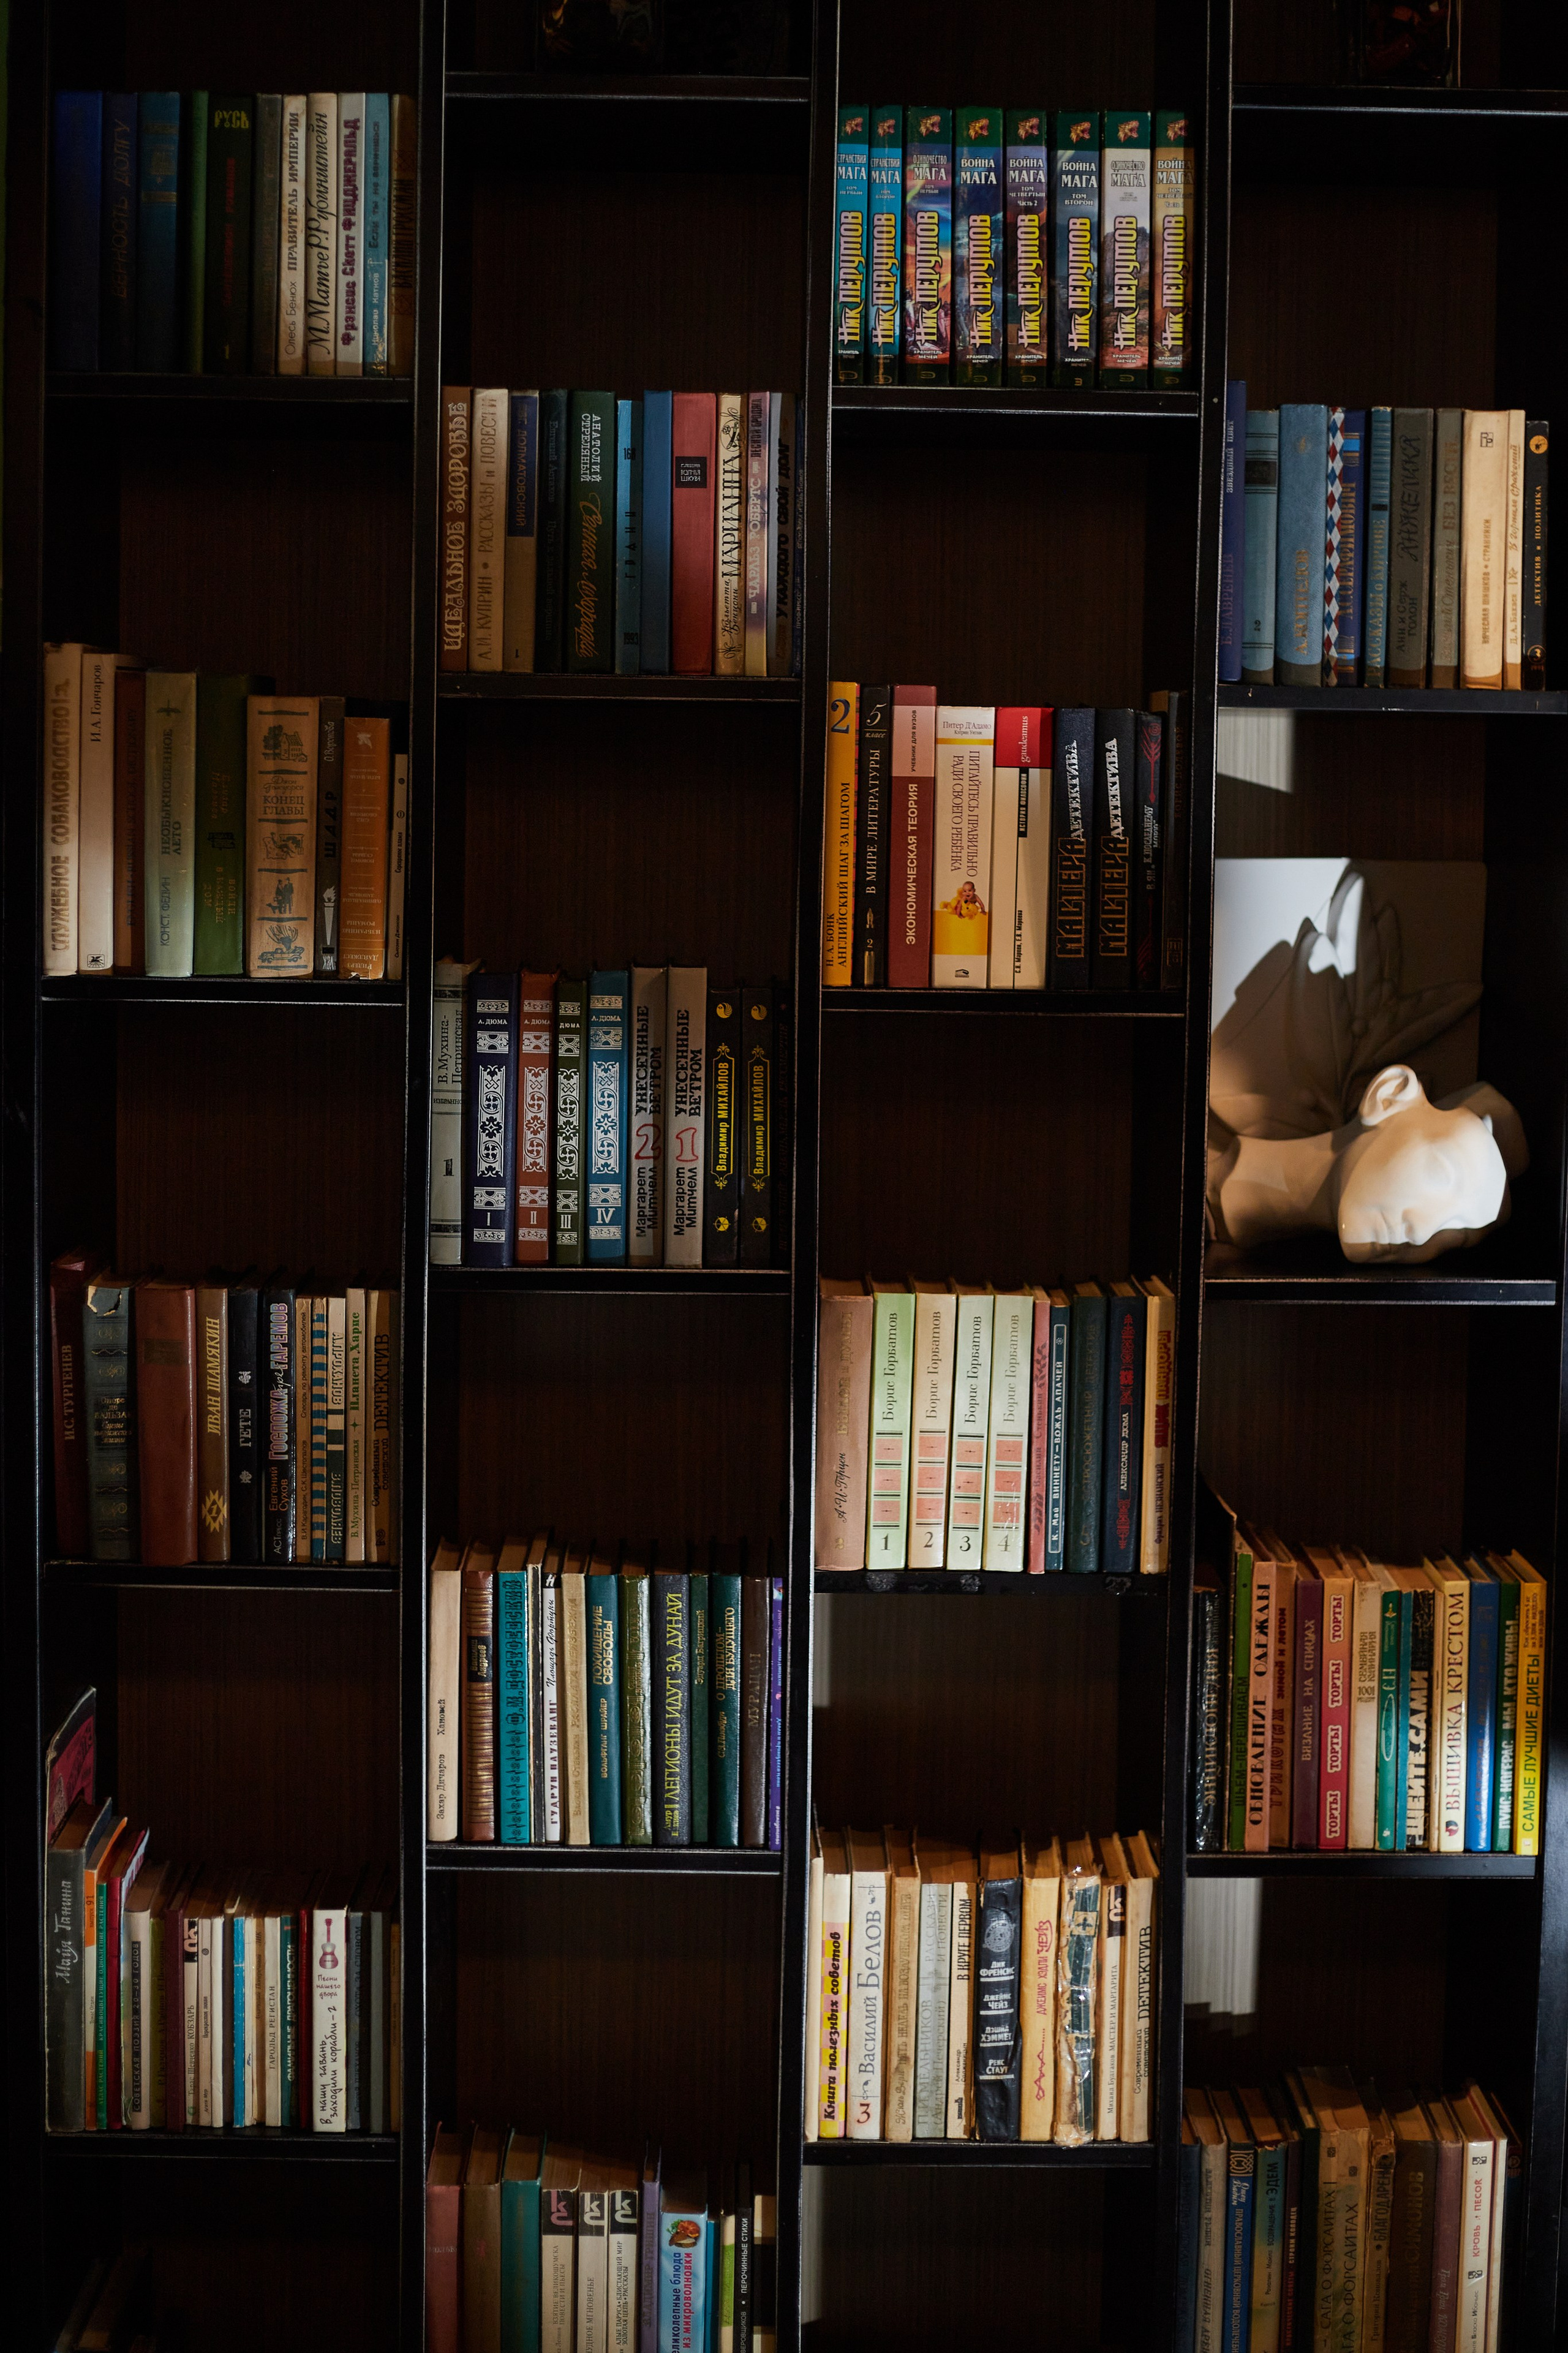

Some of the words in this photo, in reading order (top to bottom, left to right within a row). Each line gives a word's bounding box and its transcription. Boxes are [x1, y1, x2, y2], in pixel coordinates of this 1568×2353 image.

[214, 110, 249, 129] РУСЬ
[288, 113, 298, 183] ИМПЕРИИ
[342, 119, 360, 231] ФИЦДЖЕРАЛЬД
[961, 159, 995, 168] ВОЙНА
[1008, 159, 1044, 168] ВОЙНА
[1008, 170, 1046, 182] МАГА
[1061, 161, 1096, 171] ВОЙНА
[961, 172, 997, 184] МАГА
[1061, 175, 1098, 187] МАГА
[287, 189, 298, 271] ПРАВИТЕЛЬ
[285, 281, 297, 316] Бенюх
[341, 281, 357, 346] Фрэнсис
[285, 321, 297, 355] Олесь
[448, 402, 468, 513] ЗДОРОВЬЕ
[480, 398, 496, 464] ПОВЕСТИ
[580, 414, 590, 482] СТРЕЛЯНЫЙ
[591, 414, 601, 482] АНАТОЛИЙ
[478, 483, 495, 552] РАССКАЗЫ
[722, 453, 742, 577] МАРИАННА
[750, 478, 761, 538] РОБЕРТС
[1397, 434, 1420, 561] АНЖЕЛИКА
[444, 521, 466, 650] ИДЕАЛЬНОЕ
[748, 546, 760, 599] ЧАРЛЬЗ
[476, 576, 492, 629] КУПРИН
[1365, 594, 1382, 677] РАССКАЗЫ
[91, 665, 102, 715] Гончаров
[831, 698, 850, 734] 2
[1020, 716, 1030, 762] gaudeamus
[51, 706, 69, 845] СОБАКОВОДСТВО
[161, 729, 173, 855] НЕОБЫКНОВЕННОЕ
[867, 749, 880, 840] ЛИТЕРАТУРЫ
[1065, 740, 1084, 841] ДЕТЕКТИВА
[1104, 738, 1124, 839] ДЕТЕКТИВА
[840, 782, 850, 830] ШАГОМ
[908, 784, 918, 831] ТЕОРИЯ
[951, 785, 962, 823] СВОЕГО
[172, 821, 181, 855] ЛЕТО
[839, 833, 849, 847] ЗА
[839, 850, 849, 877] ШАГ
[867, 845, 877, 881] МИРЕ
[966, 814, 978, 876] ПРАВИЛЬНО
[51, 856, 69, 951] СЛУЖЕБНОЕ
[907, 835, 917, 945] ЭКОНОМИЧЕСКАЯ
[1056, 838, 1085, 957] МАСТЕРА
[1099, 837, 1128, 956] МАСТЕРА
[826, 913, 835, 942] БОНК
[837, 881, 848, 968] АНГЛИЙСКИЙ
[437, 1015, 450, 1070] Мухина-
[452, 1010, 463, 1083] Петринская
[635, 1006, 649, 1116] УНЕСЕННЫЕ
[675, 1010, 688, 1117] УНЕСЕННЫЕ
[437, 1072, 448, 1084] В.
[649, 1046, 662, 1114] ВЕТРОМ
[689, 1049, 702, 1117] ВЕТРОМ
[717, 1062, 729, 1118] МИХАЙЛОВ
[752, 1065, 764, 1122] МИХАЙЛОВ
[715, 1122, 729, 1171] Владимир
[752, 1125, 765, 1174] Владимир
[674, 1167, 685, 1235] Маргарет
[686, 1167, 697, 1228] Митчелл
[206, 1318, 220, 1393] ШАМЯКИН
[884, 1313, 897, 1375] Горбатов
[927, 1311, 940, 1374] Горбатов
[967, 1316, 981, 1379] Горбатов
[1005, 1315, 1018, 1377] Горбатов
[61, 1344, 74, 1415] ТУРГЕНЕВ
[350, 1357, 360, 1410] Планета
[374, 1334, 390, 1430] ДЕТЕКТИВ
[883, 1381, 895, 1421] Борис
[926, 1380, 938, 1419] Борис
[965, 1384, 978, 1422] Борис
[1003, 1383, 1017, 1421] Борис
[1054, 1361, 1063, 1402] АПАЧЕЙ
[208, 1396, 221, 1435] ИВАН
[239, 1409, 251, 1447] ГЕТЕ
[270, 1467, 279, 1511] Евгений
[279, 1479, 289, 1511] Сухов
[350, 1440, 360, 1528] Мухина-Петринская
[592, 1606, 603, 1685] ПОХИЩЕНИЕ
[665, 1593, 683, 1649] ДУНАЙ
[1303, 1620, 1316, 1671] СПИЦАХ
[1332, 1596, 1343, 1640] ТОРТЫ
[1447, 1592, 1463, 1694] КРЕСТОМ
[603, 1621, 612, 1685] СВОБОДЫ
[666, 1653, 681, 1671] ЗА
[1525, 1655, 1540, 1707] ДИЕТЫ
[666, 1677, 682, 1718] ИДУТ
[1303, 1678, 1313, 1696] НА
[1329, 1662, 1340, 1705] ТОРТЫ
[1409, 1670, 1428, 1745] САМИ
[665, 1723, 681, 1799] ЛЕГИОНЫ
[1250, 1696, 1266, 1825] ОБНОВЛЕНИЕ
[1302, 1705, 1313, 1761] ВЯЗАНИЕ
[1329, 1727, 1340, 1770] ТОРТЫ
[1446, 1703, 1462, 1811] ВЫШИВКА
[1524, 1710, 1538, 1773] ЛУЧШИЕ
[437, 1794, 447, 1819] Захар
[1328, 1792, 1339, 1836] ТОРТЫ
[1523, 1778, 1536, 1831] САМЫЕ
[86, 1894, 95, 1906] 91
[829, 1932, 840, 1995] советов
[826, 2001, 839, 2071] полезных
[858, 1996, 876, 2075] Василий
[330, 2070, 342, 2118] заходили
[824, 2077, 837, 2120] Книга
[1266, 2162, 1278, 2195] ЭДЕМ
[1322, 2191, 1336, 2273] ФОРСАЙТАХ
[1404, 2171, 1424, 2262] СИМОНОВ
[671, 2253, 681, 2284] блюда
[1343, 2203, 1358, 2305] ФОРСАЙТАХ
[683, 2253, 693, 2333] микроволновки
[1321, 2295, 1332, 2328] САГА
[1322, 2280, 1332, 2290] О
[683, 2337, 690, 2348] из
[1343, 2312, 1355, 2324] О
